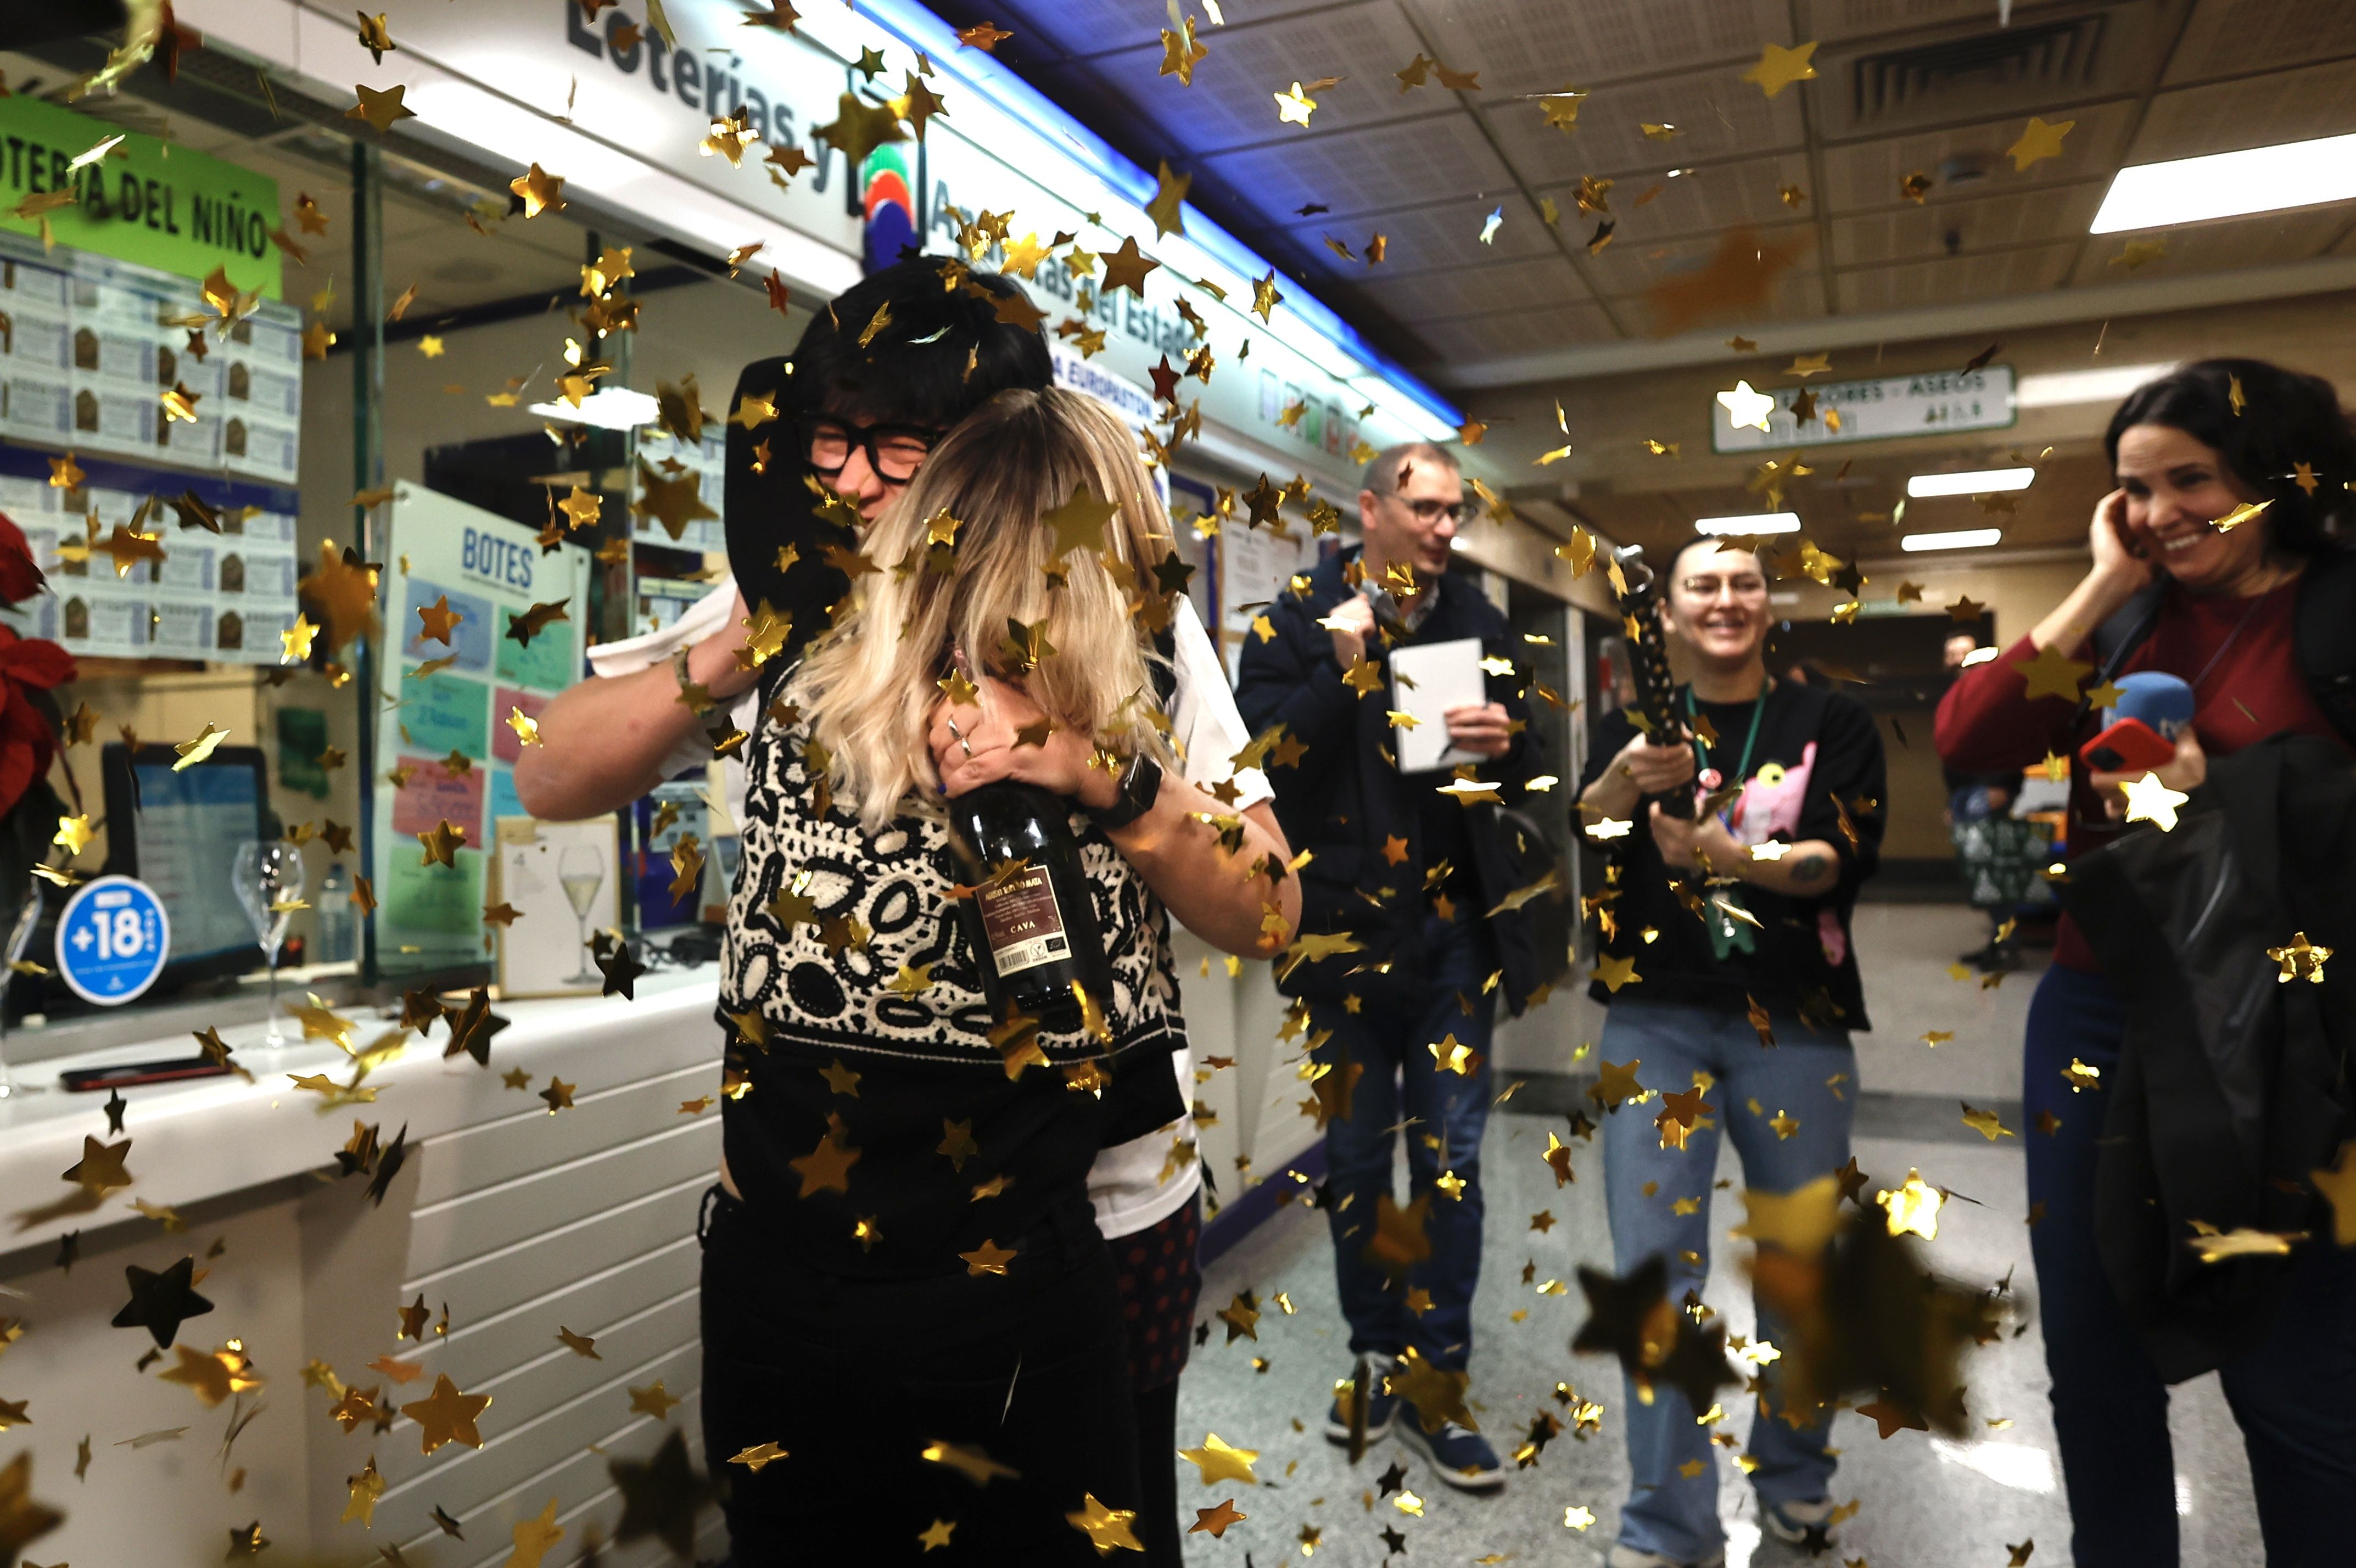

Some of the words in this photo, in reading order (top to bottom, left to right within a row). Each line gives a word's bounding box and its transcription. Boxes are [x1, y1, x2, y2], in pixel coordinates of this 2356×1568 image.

[120, 172, 179, 235] DEL
[192, 190, 267, 259] NIÑO
[463, 527, 533, 588] BOTES
[71, 908, 144, 960] +18
[1011, 921, 1036, 933] CAVA
